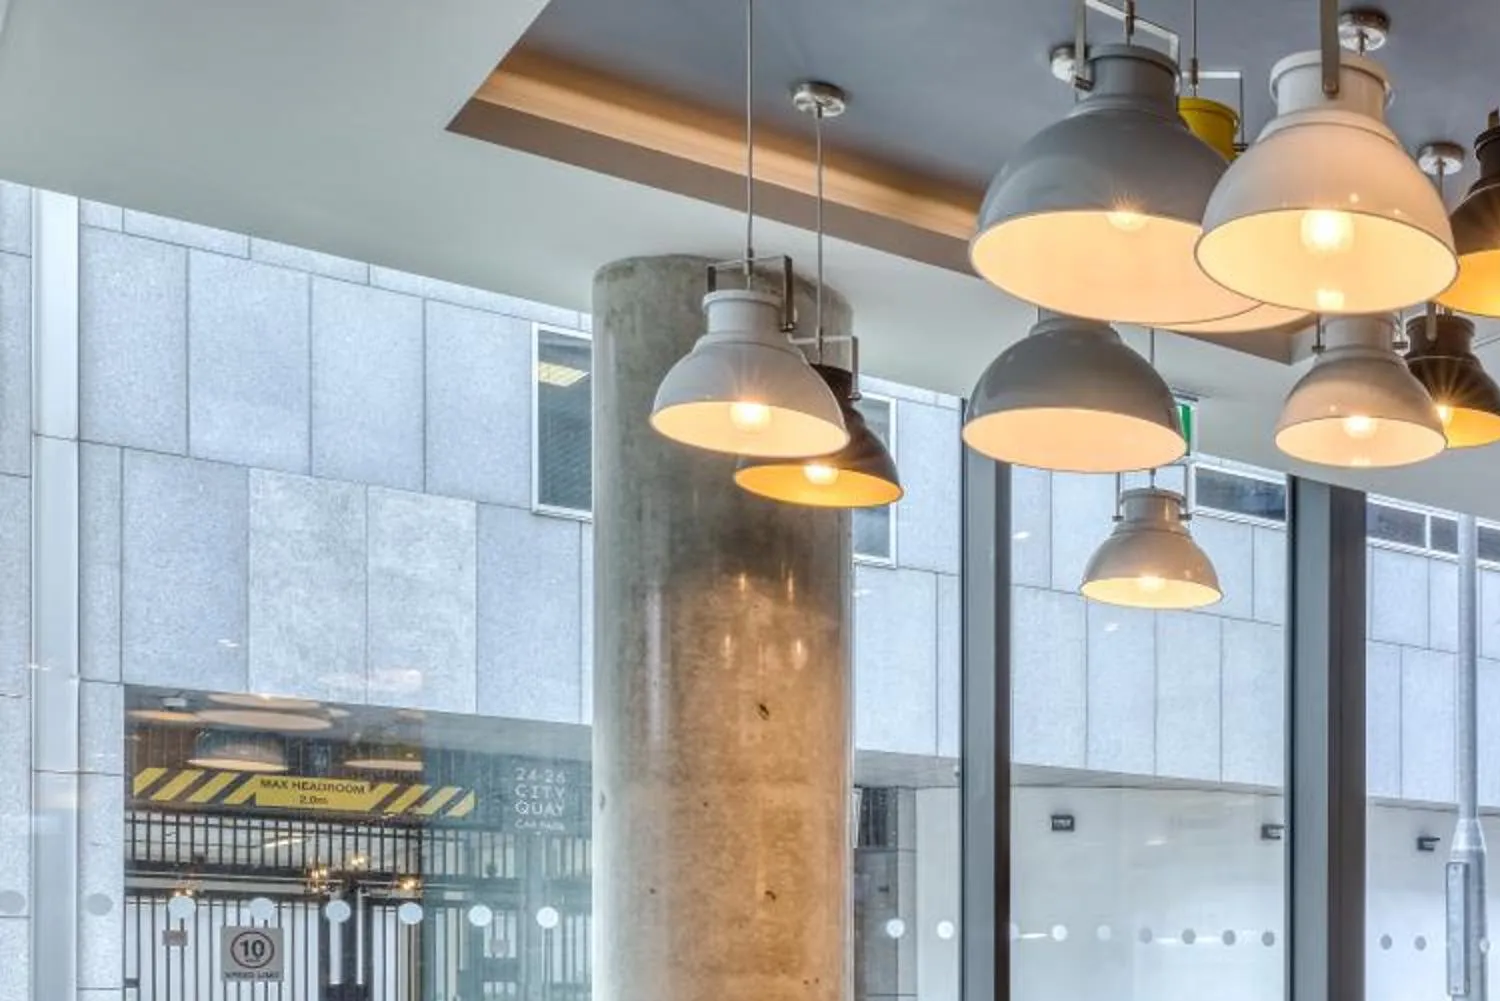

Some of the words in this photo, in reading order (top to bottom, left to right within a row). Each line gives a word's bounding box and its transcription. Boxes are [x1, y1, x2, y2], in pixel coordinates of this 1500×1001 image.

[260, 778, 289, 789] MAX
[292, 780, 365, 794] HEADROOM
[514, 784, 565, 799] CITY
[514, 800, 565, 818] QUAY
[240, 939, 265, 958] 10
